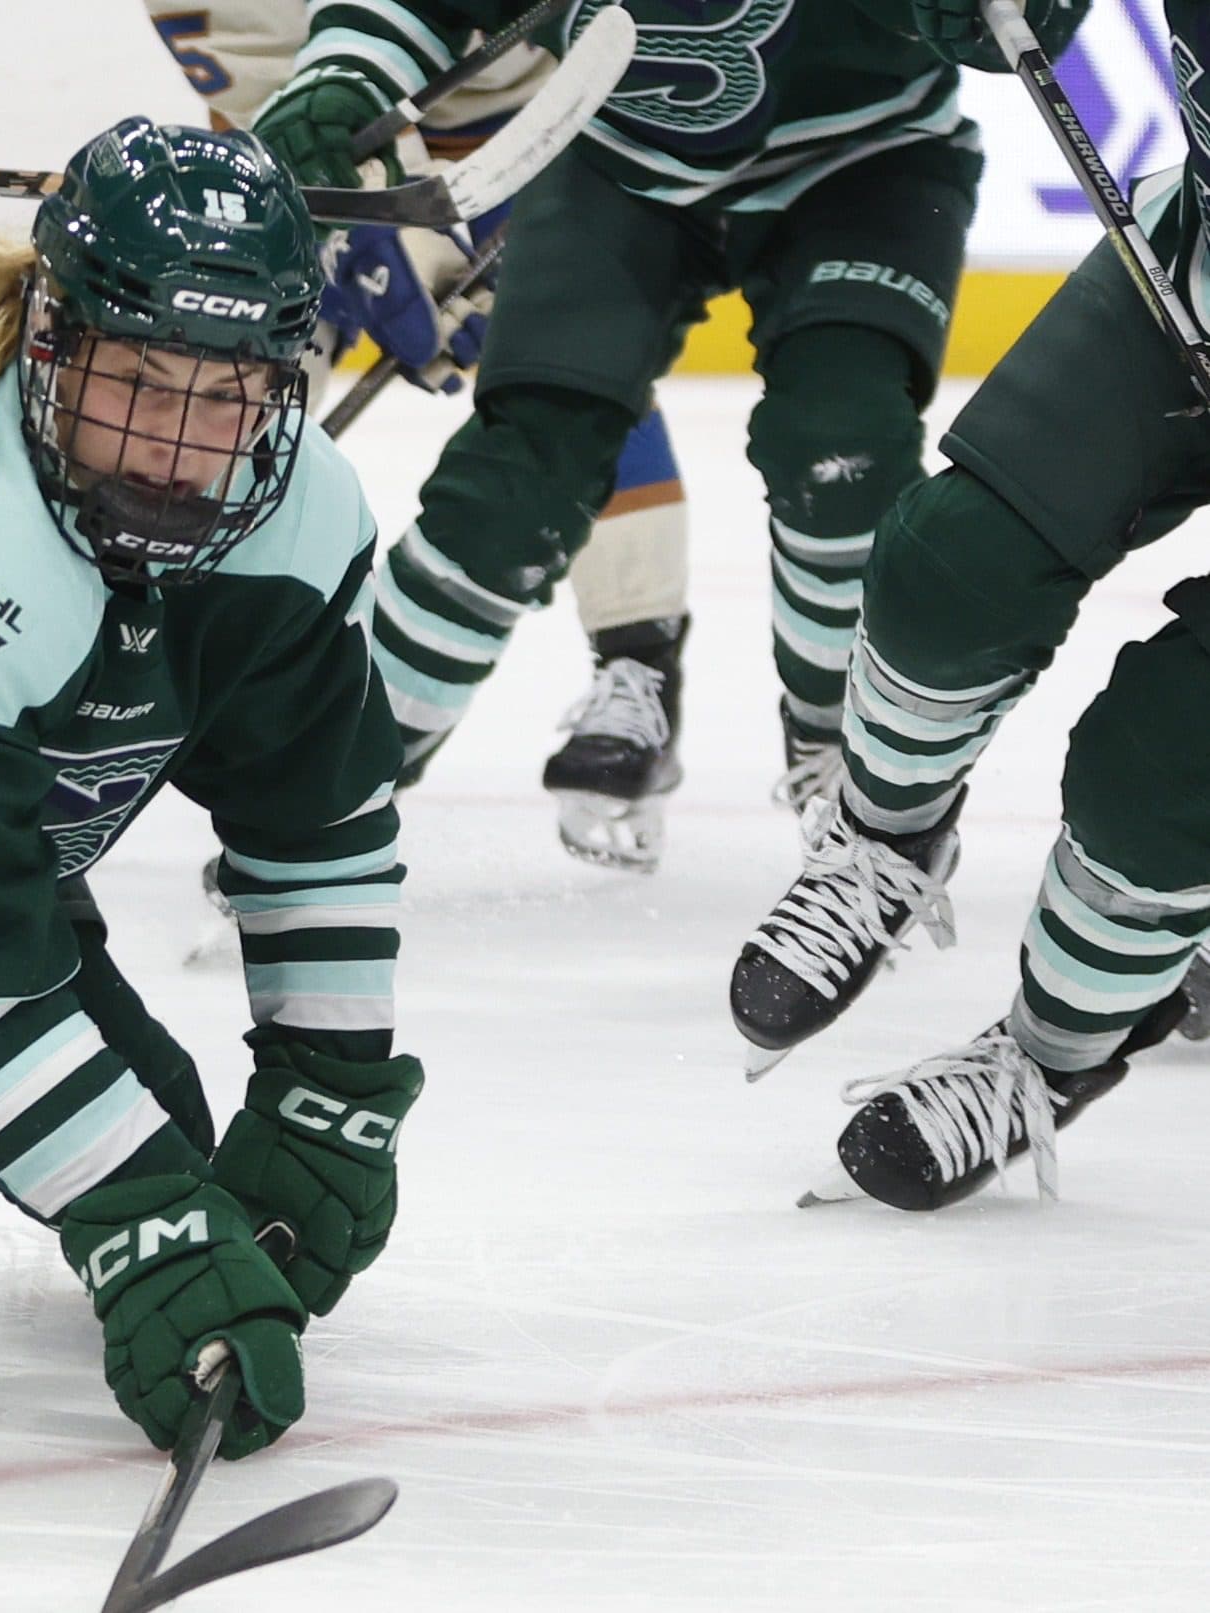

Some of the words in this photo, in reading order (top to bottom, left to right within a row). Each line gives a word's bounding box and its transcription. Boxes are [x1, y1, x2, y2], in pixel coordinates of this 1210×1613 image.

[1053, 102, 1131, 218] SHERWOOD
[202, 187, 248, 224] 15
[171, 288, 268, 322] CCM
[277, 1086, 404, 1153] CC
[80, 1209, 209, 1298] CM
